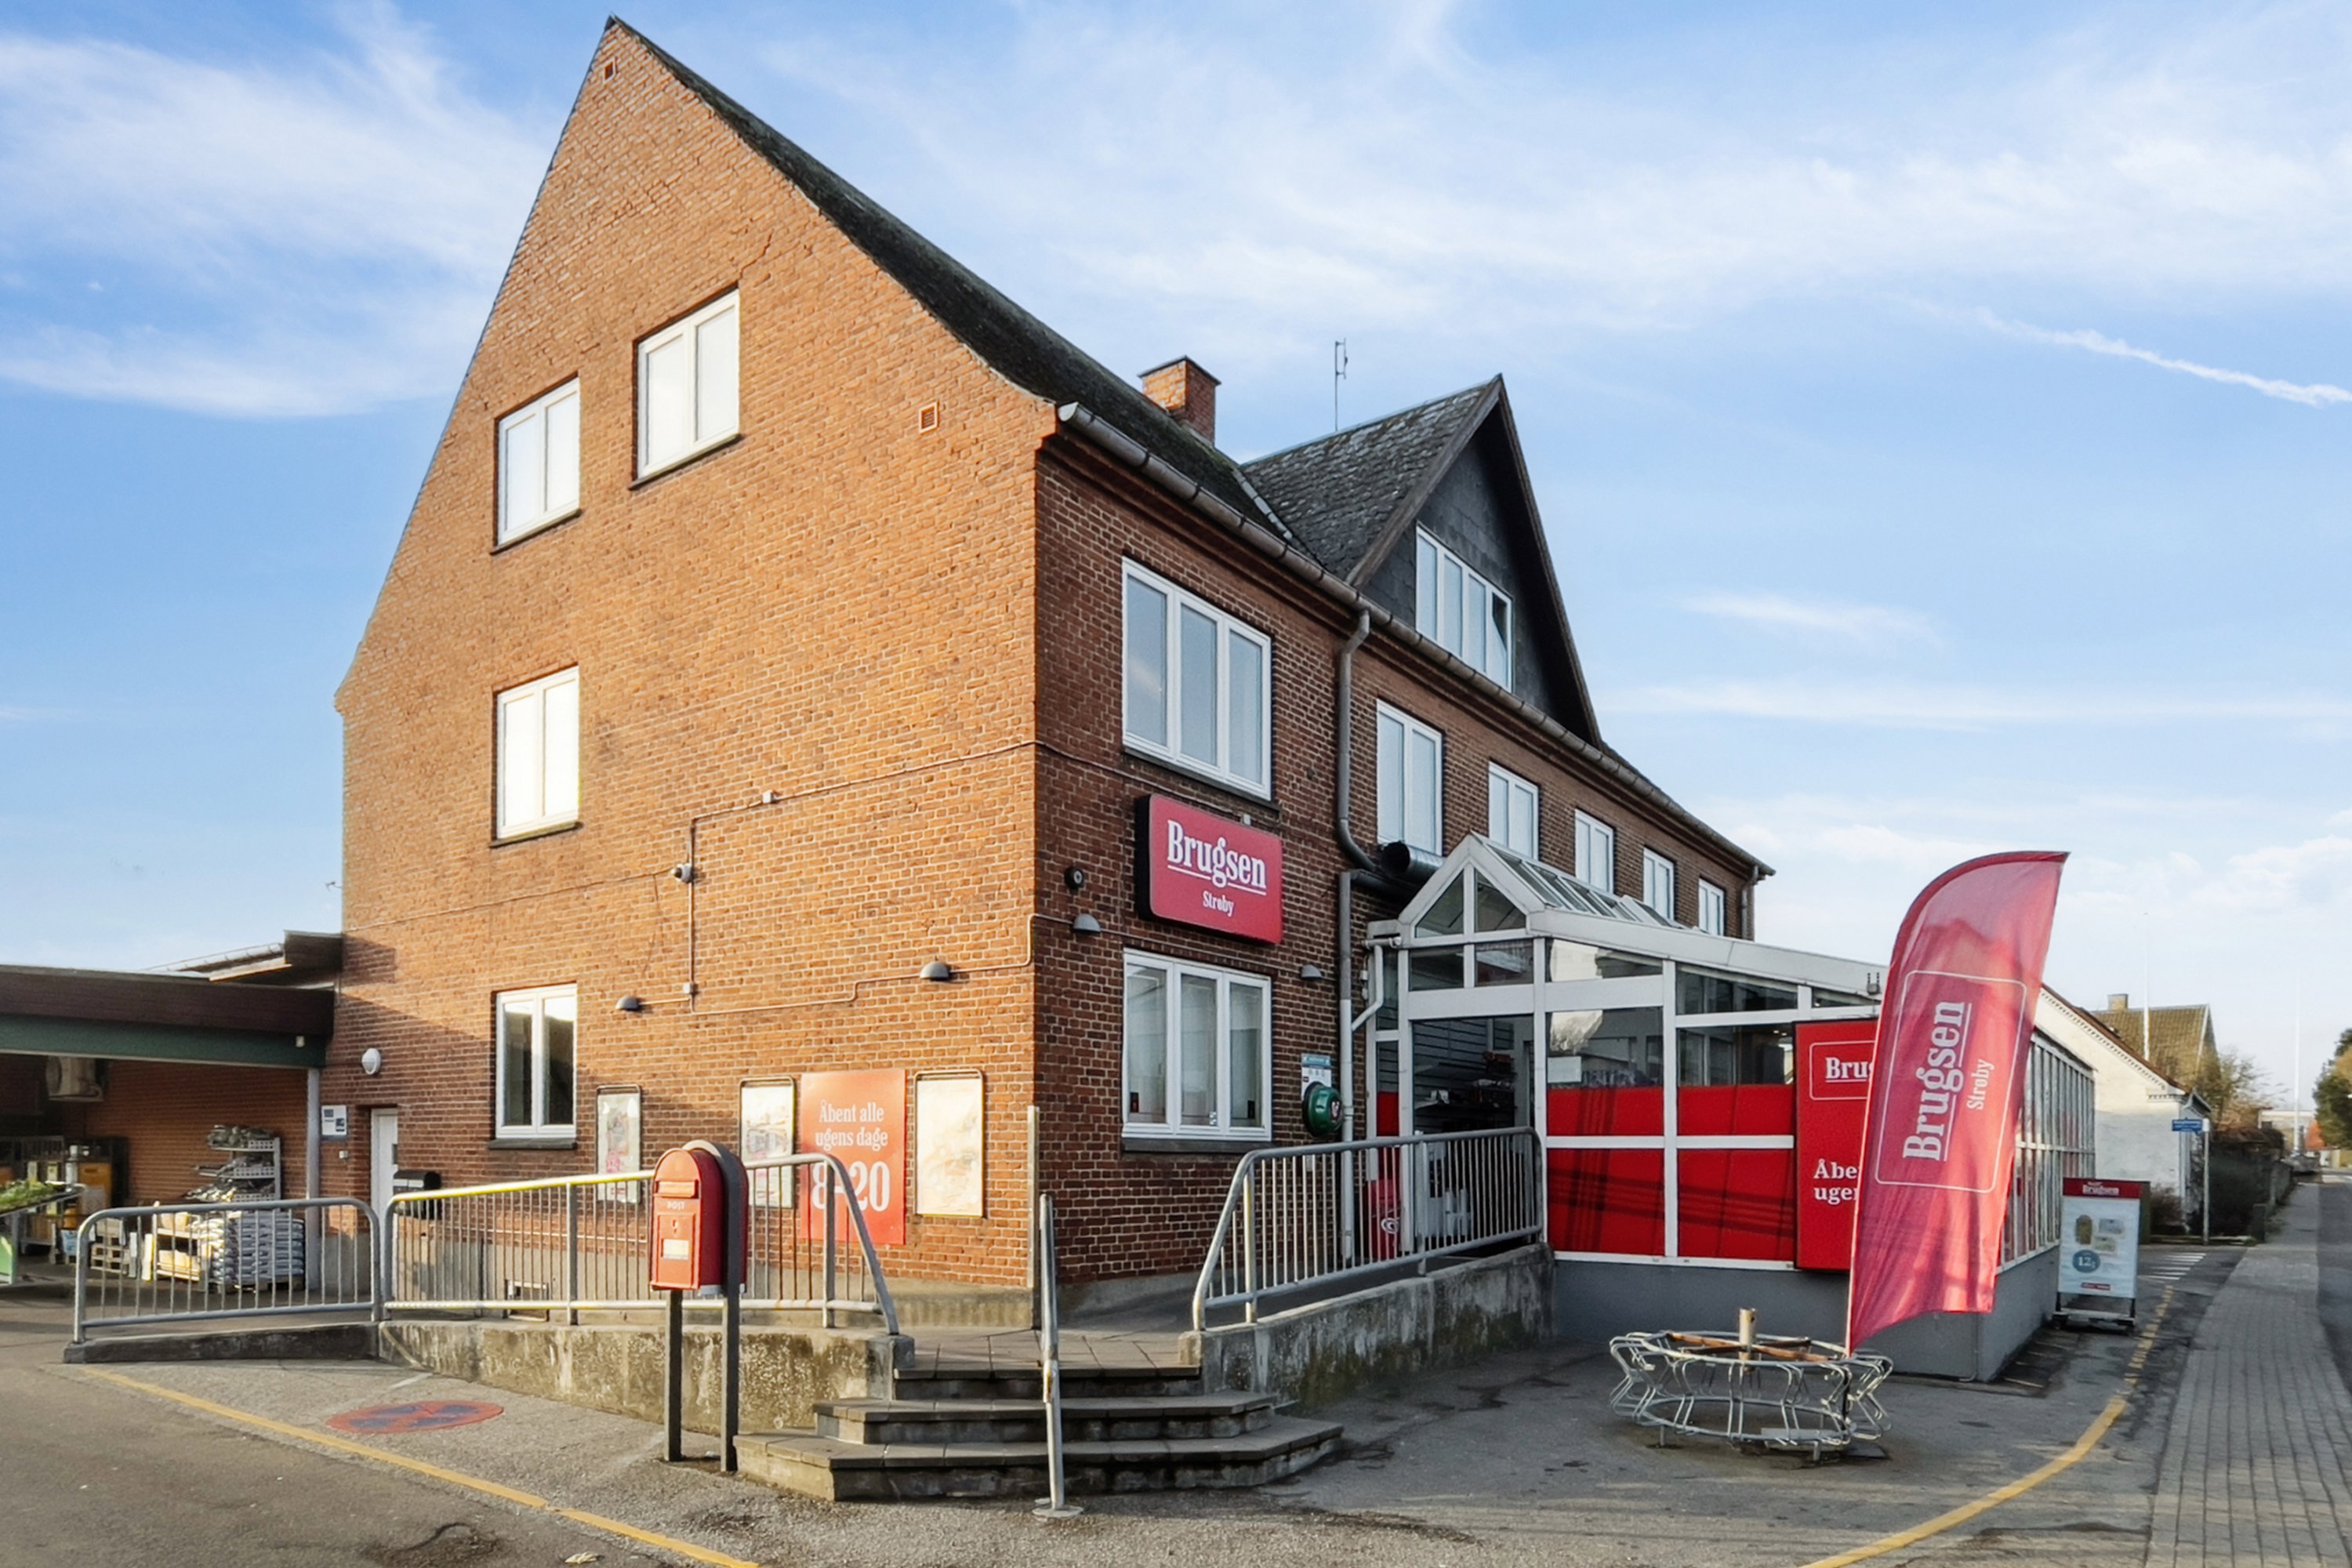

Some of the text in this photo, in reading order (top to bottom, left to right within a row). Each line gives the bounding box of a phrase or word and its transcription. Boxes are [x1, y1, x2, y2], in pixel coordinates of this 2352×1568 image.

[1167, 818, 1267, 889] Brugsen
[1824, 1056, 1873, 1080] Bru
[1902, 1000, 1965, 1162] Brugsen
[819, 1099, 884, 1123] Åbent alle
[815, 1126, 888, 1152] ugens dage
[1813, 1158, 1860, 1180] Åbe
